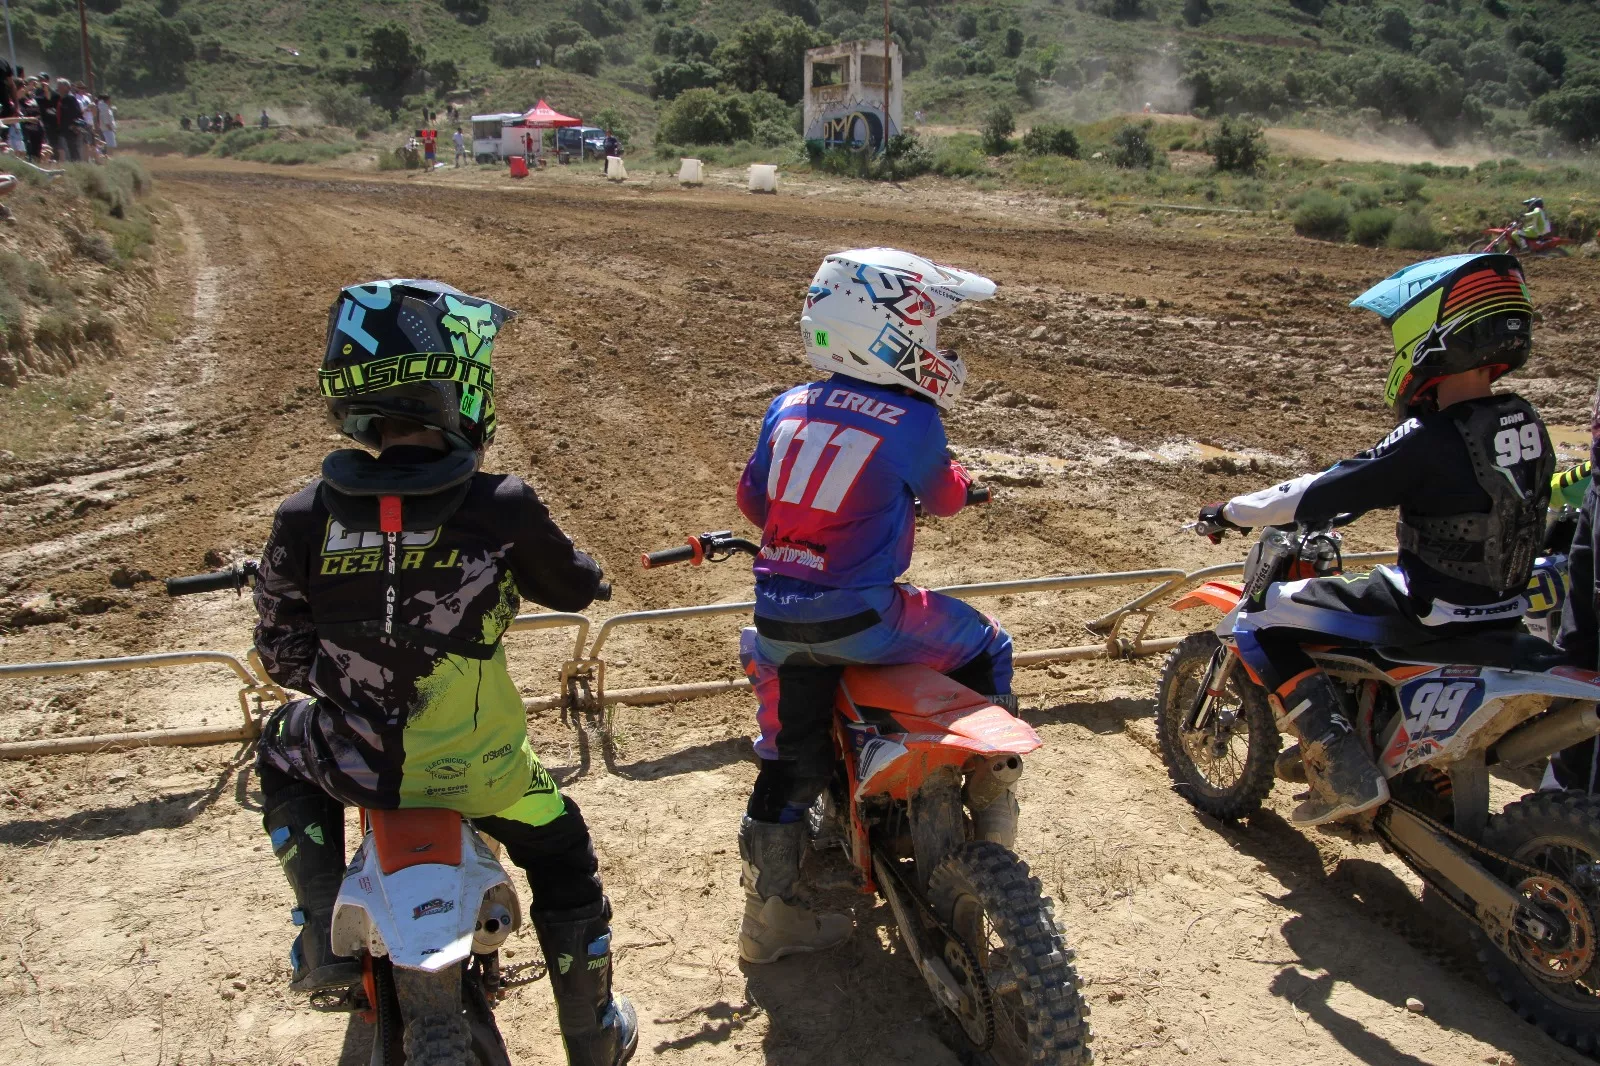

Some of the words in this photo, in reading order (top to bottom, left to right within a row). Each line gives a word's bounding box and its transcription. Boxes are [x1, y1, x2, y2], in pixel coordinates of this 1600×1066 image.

[338, 279, 402, 356] FO
[816, 332, 827, 346] OK
[364, 353, 491, 391] SCOTT
[462, 396, 475, 412] OK
[824, 389, 907, 425] CRUZ
[1500, 412, 1524, 427] DANI
[1366, 417, 1420, 460] THOR
[1494, 423, 1542, 467] 99
[767, 418, 882, 514] 111
[320, 551, 425, 575] CESR
[1405, 682, 1476, 733] 99
[425, 757, 471, 773] ELECTRICIDAD
[587, 955, 609, 970] THOR
